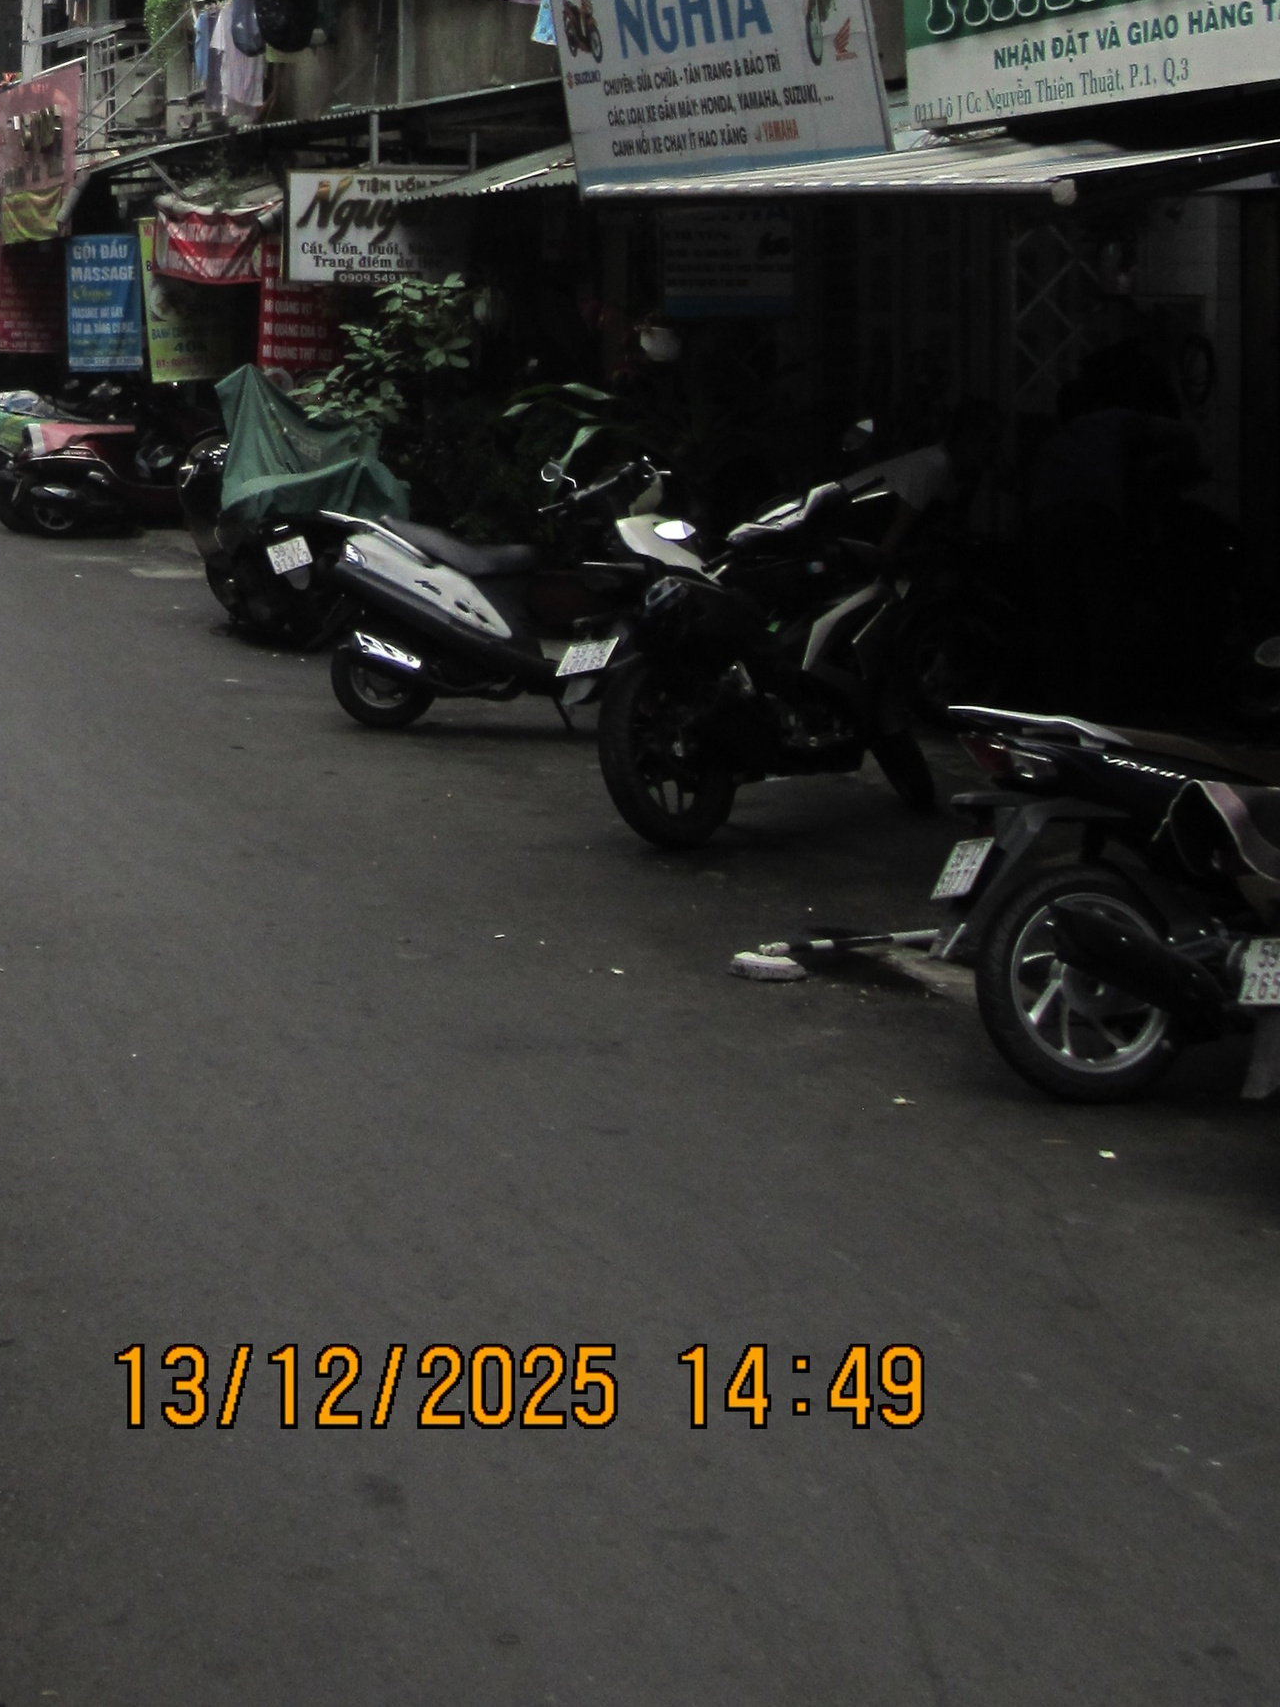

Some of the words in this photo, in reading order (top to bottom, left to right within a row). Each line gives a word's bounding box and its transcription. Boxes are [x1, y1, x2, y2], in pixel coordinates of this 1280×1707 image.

[994, 38, 1046, 70] NHẬN
[1051, 29, 1089, 62] ĐẶT
[1096, 24, 1122, 50] VÀ
[1127, 15, 1179, 46] GIAO
[1188, 1, 1253, 35] HÀNG
[702, 59, 732, 81] TRANG
[1035, 76, 1076, 105] Thiện
[1163, 57, 1190, 88] Q.3
[608, 106, 626, 127] CÁC
[701, 95, 737, 115] HONDA,
[737, 89, 783, 110] YAMAHA,
[762, 118, 800, 142] YAMAHA
[71, 265, 136, 283] MASSAGE
[313, 255, 354, 270] Trang
